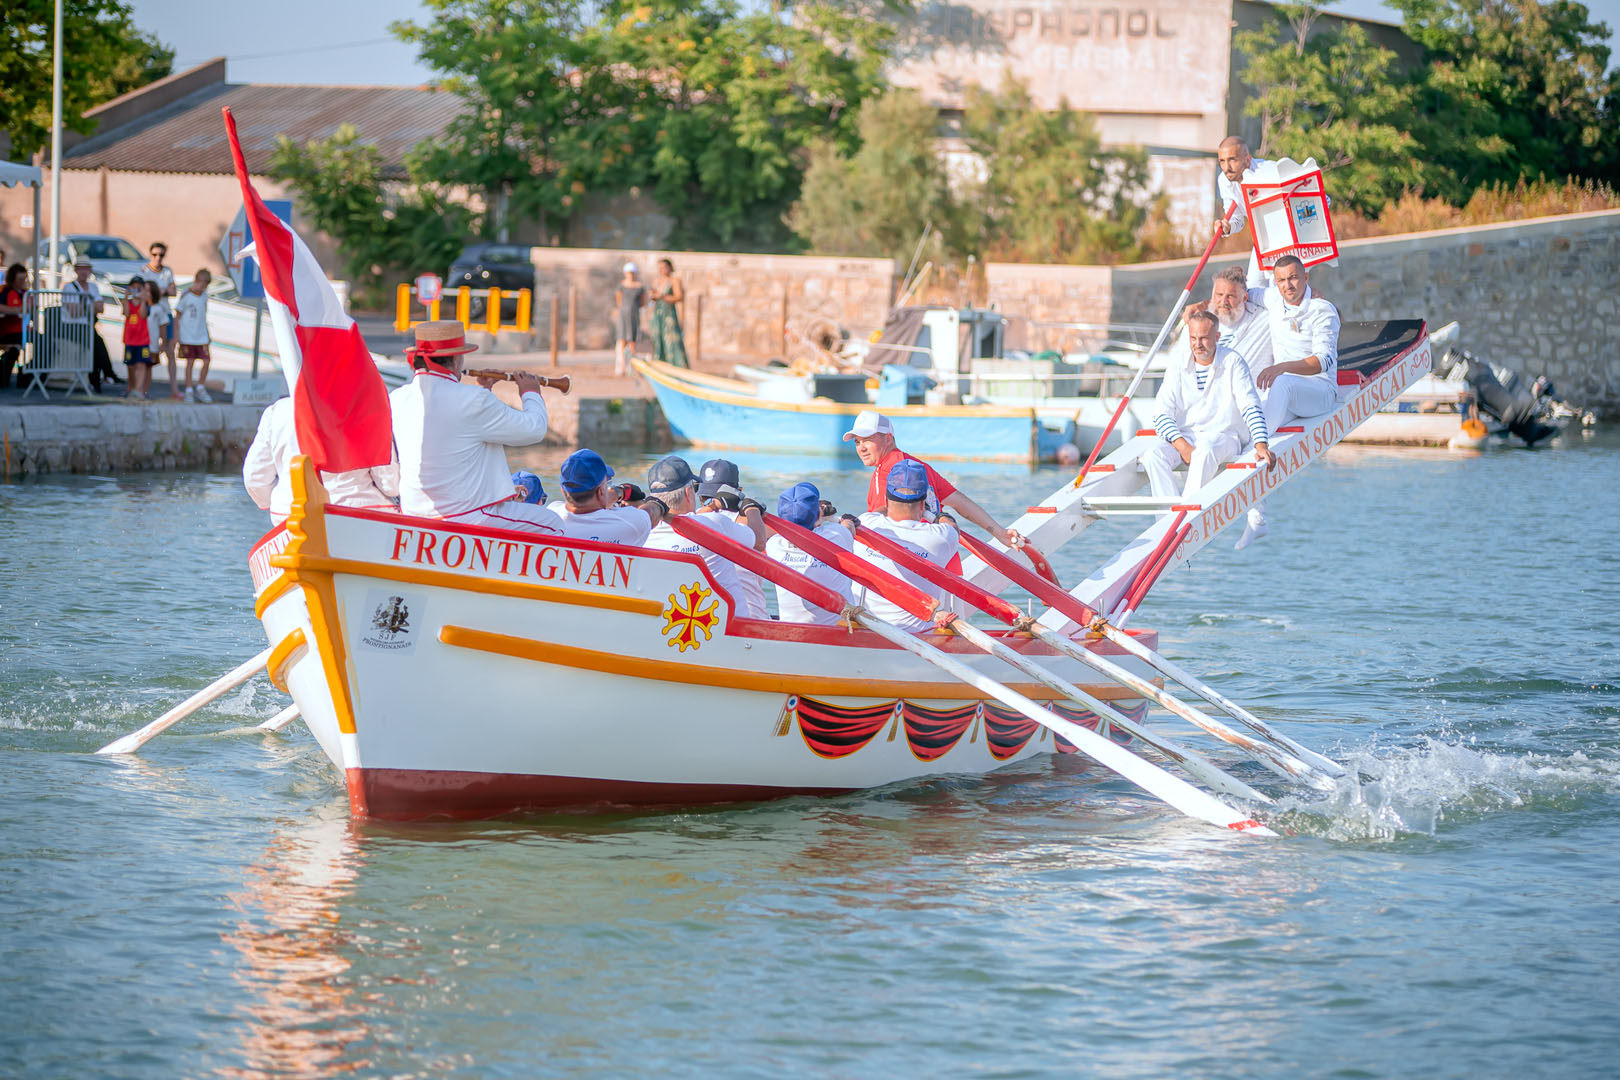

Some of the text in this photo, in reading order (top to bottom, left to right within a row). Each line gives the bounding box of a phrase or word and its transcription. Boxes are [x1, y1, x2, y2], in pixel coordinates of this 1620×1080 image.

[1202, 361, 1409, 541] FRONTIGNAN SON MUSCAT
[389, 527, 635, 590] FRONTIGNAN
